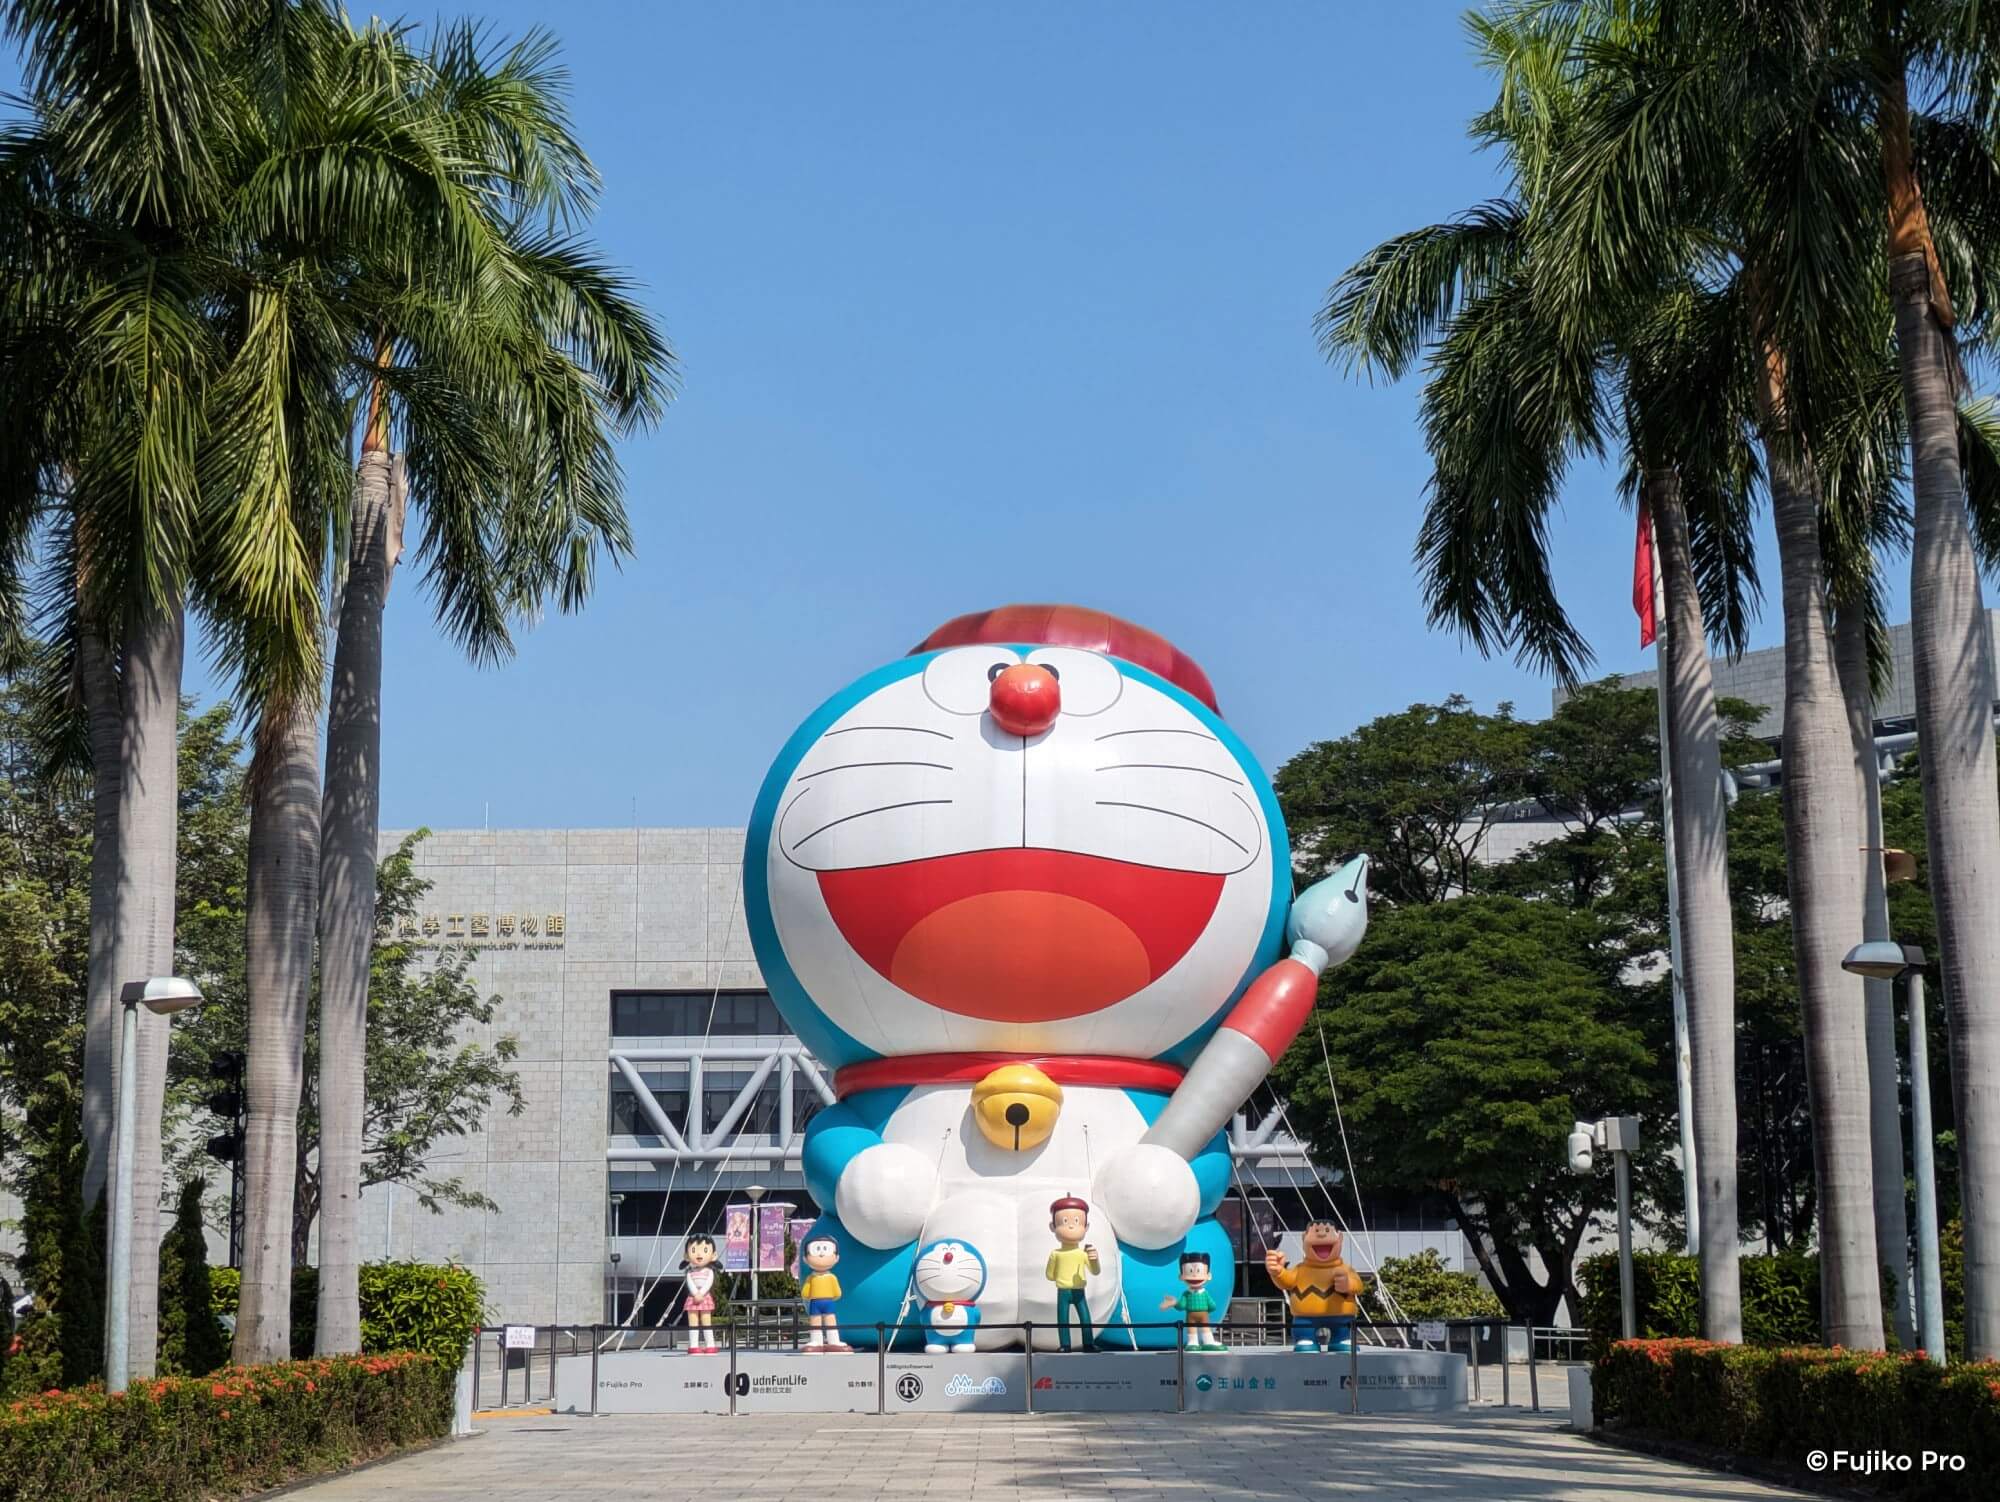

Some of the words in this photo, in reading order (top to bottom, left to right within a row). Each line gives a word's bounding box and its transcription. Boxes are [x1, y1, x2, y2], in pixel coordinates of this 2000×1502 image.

[752, 1374, 808, 1386] udnFunLife
[1218, 1376, 1276, 1390] 玉山金控
